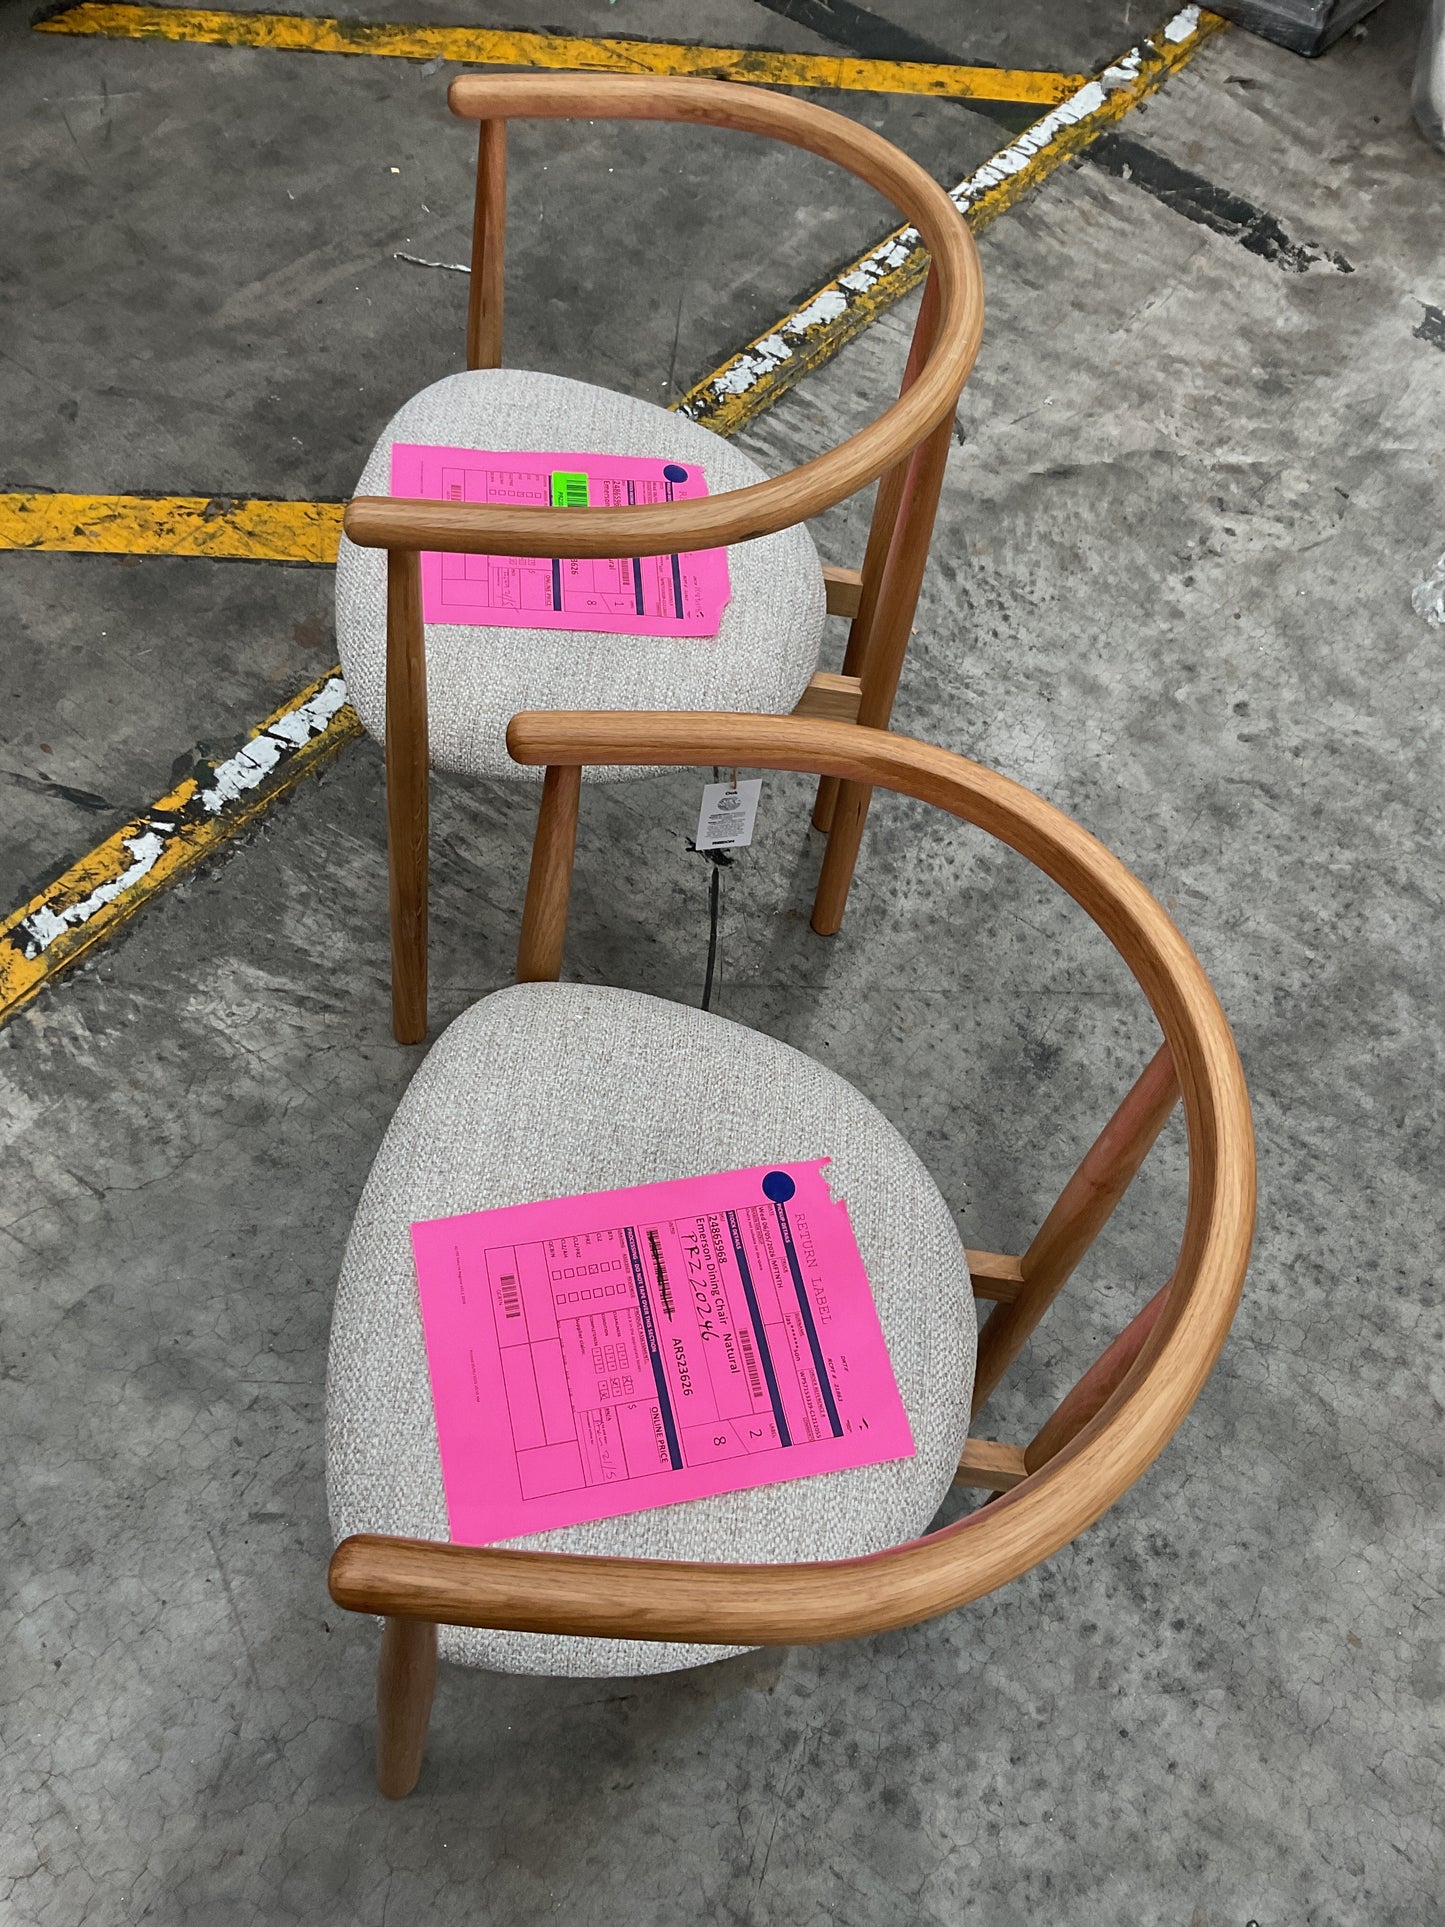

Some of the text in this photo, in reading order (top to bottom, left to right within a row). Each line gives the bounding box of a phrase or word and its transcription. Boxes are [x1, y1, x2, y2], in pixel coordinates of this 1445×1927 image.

[610, 480, 624, 507] 2486596
[568, 559, 580, 575] 3626
[607, 559, 616, 570] ural
[542, 574, 553, 591] ONLINE
[727, 1211, 742, 1249] STOCK DETAILS
[757, 1206, 776, 1258] Wed 06/05/2026
[775, 1203, 791, 1243] PICKUP DETAILS
[626, 1227, 637, 1260] PROCESSING
[707, 1215, 727, 1264] 24865968
[634, 1263, 640, 1272] DO
[770, 1259, 783, 1288] MFTNTH
[794, 1212, 832, 1325] RETURN LABEL
[638, 1285, 646, 1299] TAPE
[679, 1229, 720, 1343] PRZ 20246
[695, 1217, 740, 1374] Emerson Dining Chair Natural
[641, 1298, 649, 1315] OVER
[644, 1315, 652, 1328] THIS
[647, 1328, 657, 1353] SECTION
[671, 1336, 694, 1396] ARS23626
[650, 1405, 668, 1463] ONLINE PRICE
[712, 1434, 727, 1446] 8
[748, 1428, 763, 1439] 2
